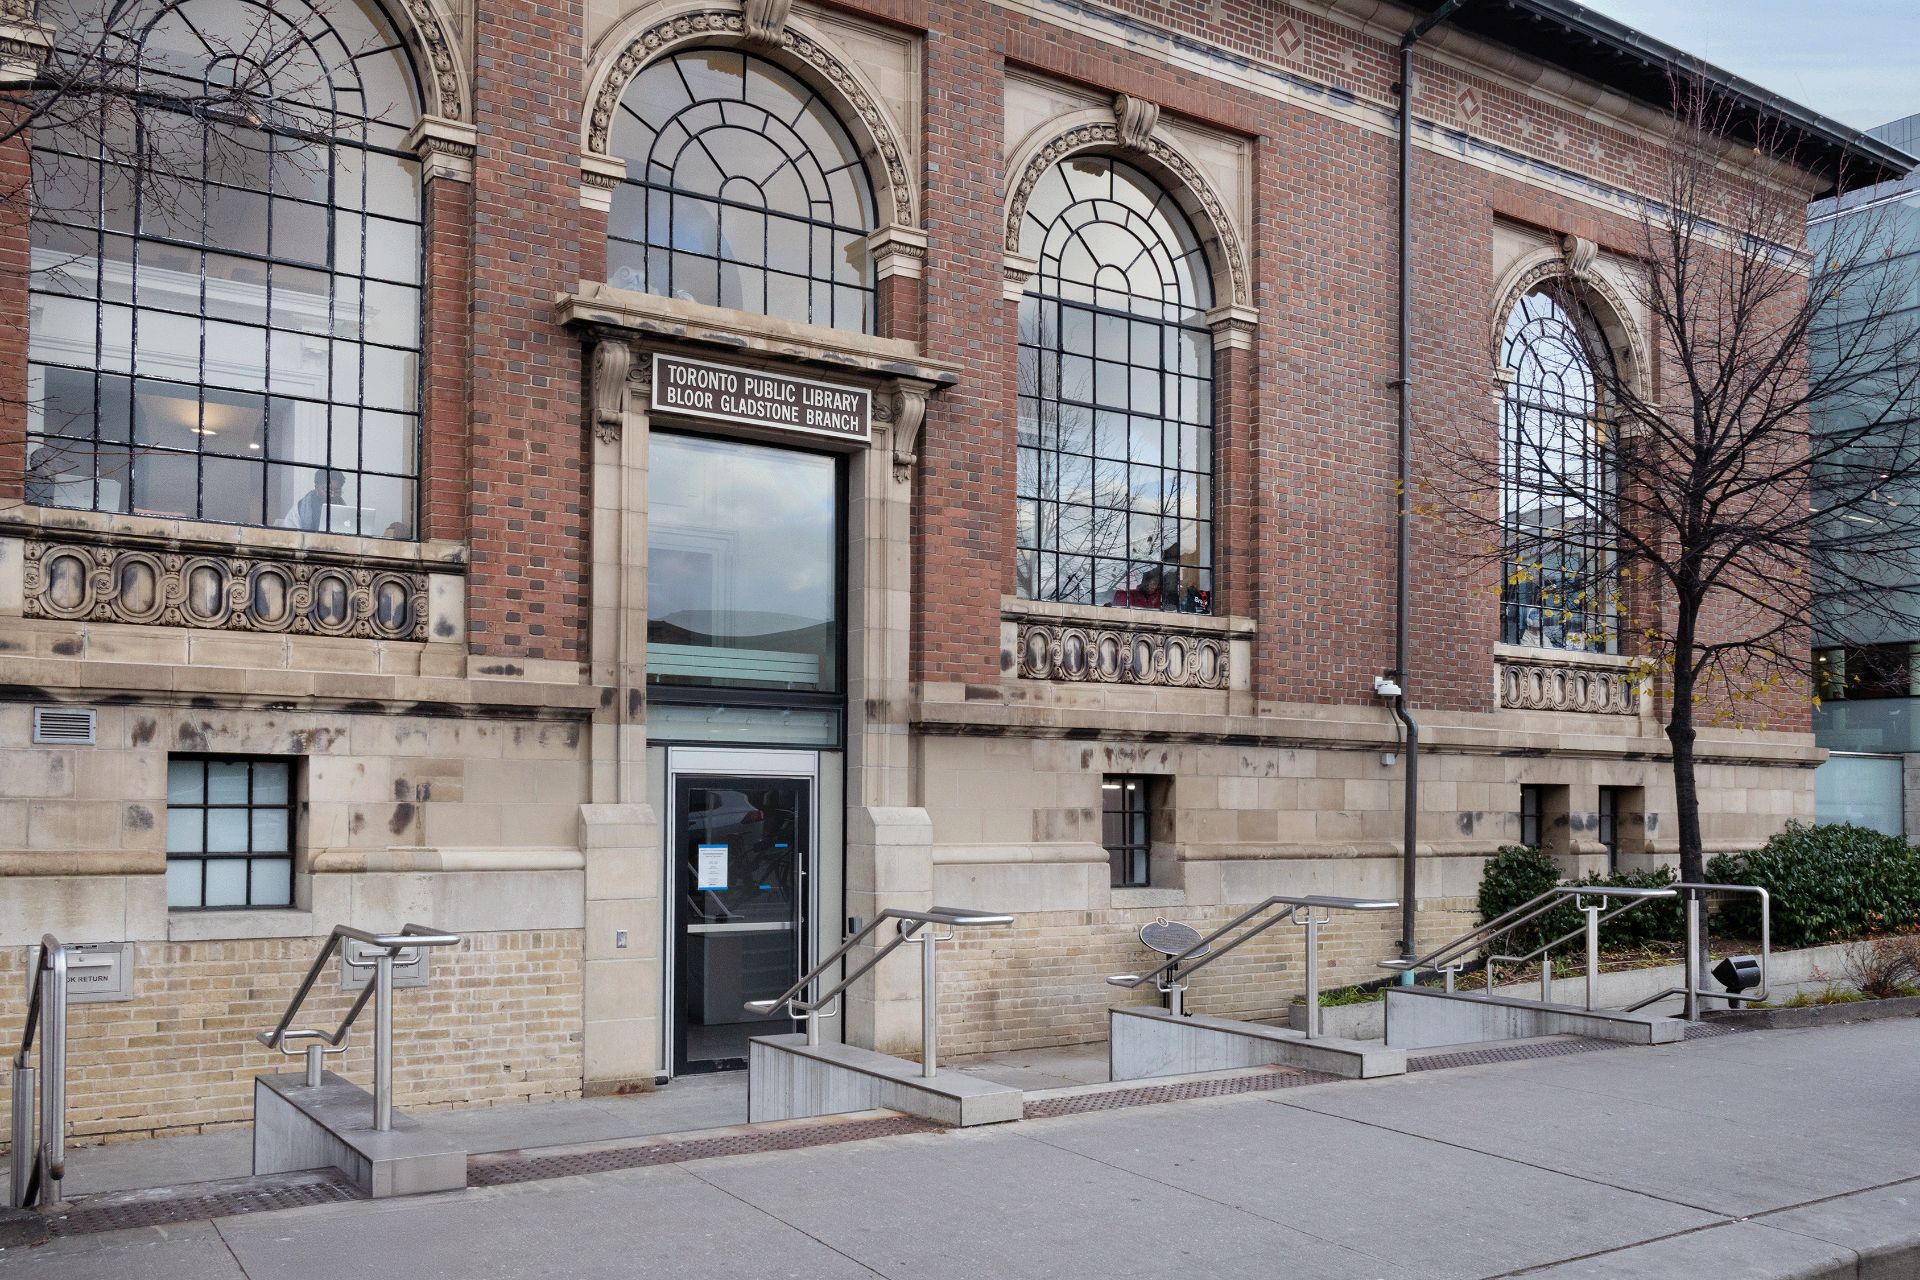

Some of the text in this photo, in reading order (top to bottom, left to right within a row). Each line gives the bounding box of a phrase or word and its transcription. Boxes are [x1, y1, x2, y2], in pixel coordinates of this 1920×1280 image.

[668, 365, 859, 412] TORONTO PUBLIC LIBRARY
[668, 387, 859, 431] BLOOR GLADSTONE BRANCH
